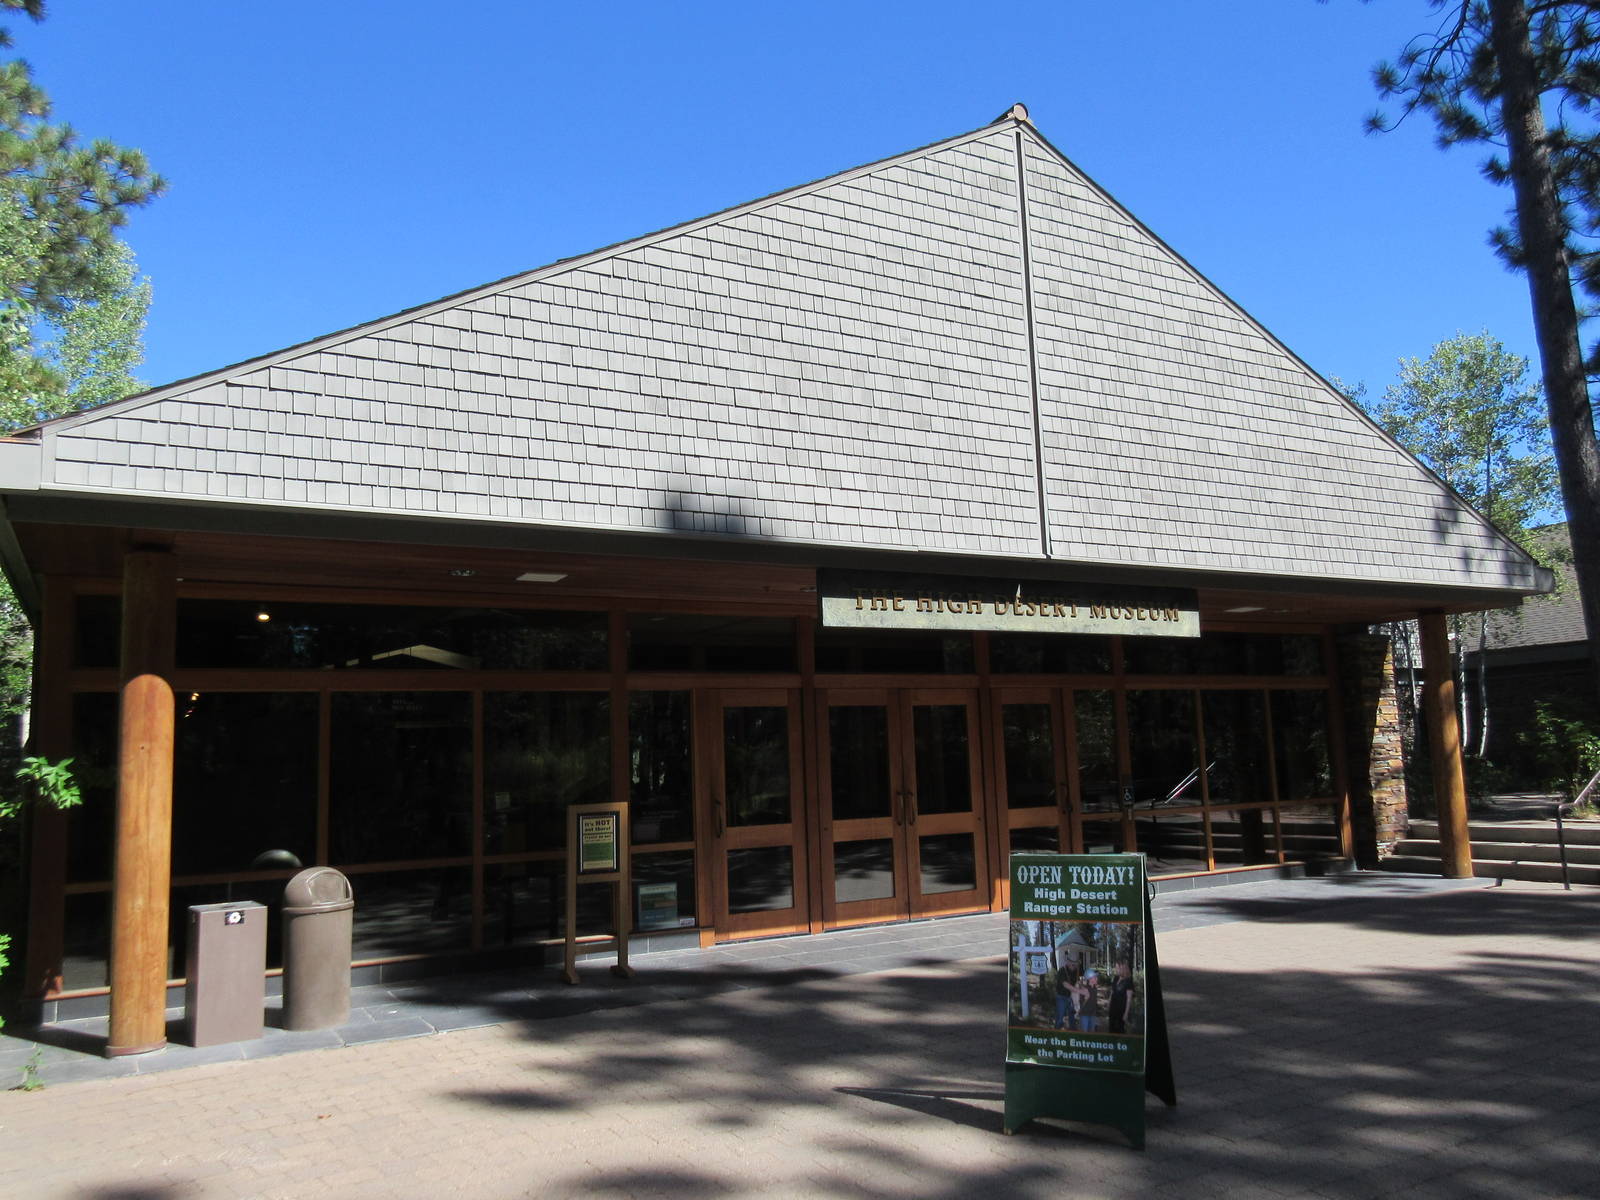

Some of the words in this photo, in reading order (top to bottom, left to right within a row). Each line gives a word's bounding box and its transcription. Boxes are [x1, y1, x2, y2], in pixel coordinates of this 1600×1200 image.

[851, 587, 905, 611] THE
[915, 590, 984, 614] HIGH
[994, 592, 1078, 618] DESERT
[1088, 599, 1180, 622] MUSEUM
[1017, 865, 1062, 884] OPEN
[1069, 866, 1135, 886] TODAY!
[1034, 887, 1066, 901] High
[1070, 889, 1117, 900] Desert
[1024, 901, 1072, 915] Ranger
[1076, 903, 1128, 915] Station
[1025, 1034, 1047, 1045] Near
[1050, 1036, 1067, 1046] the
[1069, 1038, 1114, 1050] Entrance
[1117, 1042, 1128, 1051] to
[1037, 1048, 1053, 1058] the
[1056, 1050, 1094, 1062] Parking
[1098, 1052, 1114, 1062] Lot
